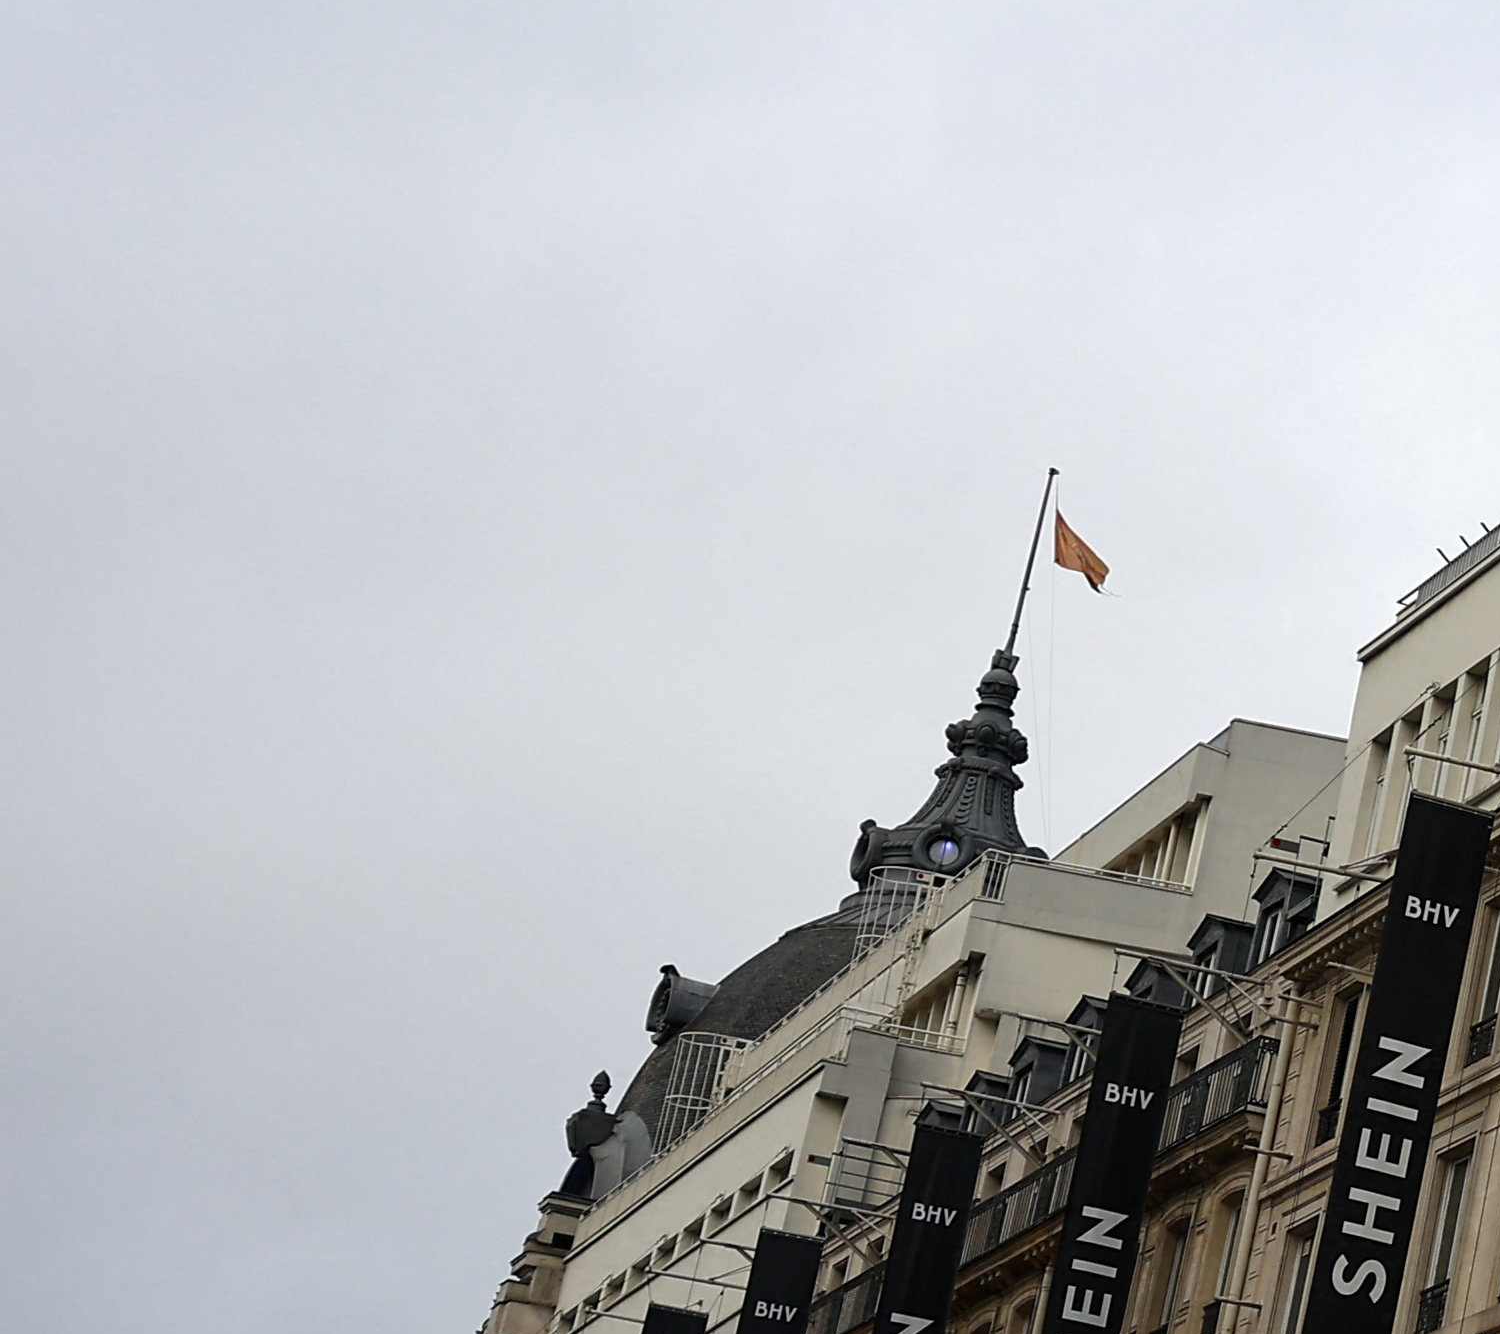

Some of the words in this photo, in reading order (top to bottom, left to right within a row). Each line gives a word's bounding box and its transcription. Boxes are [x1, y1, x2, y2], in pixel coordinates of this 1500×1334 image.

[1404, 895, 1460, 928] BHV
[1104, 1082, 1155, 1110] BHV
[1332, 1035, 1432, 1304] SHEIN
[911, 1202, 957, 1227] BHV
[754, 1300, 798, 1323] BHV
